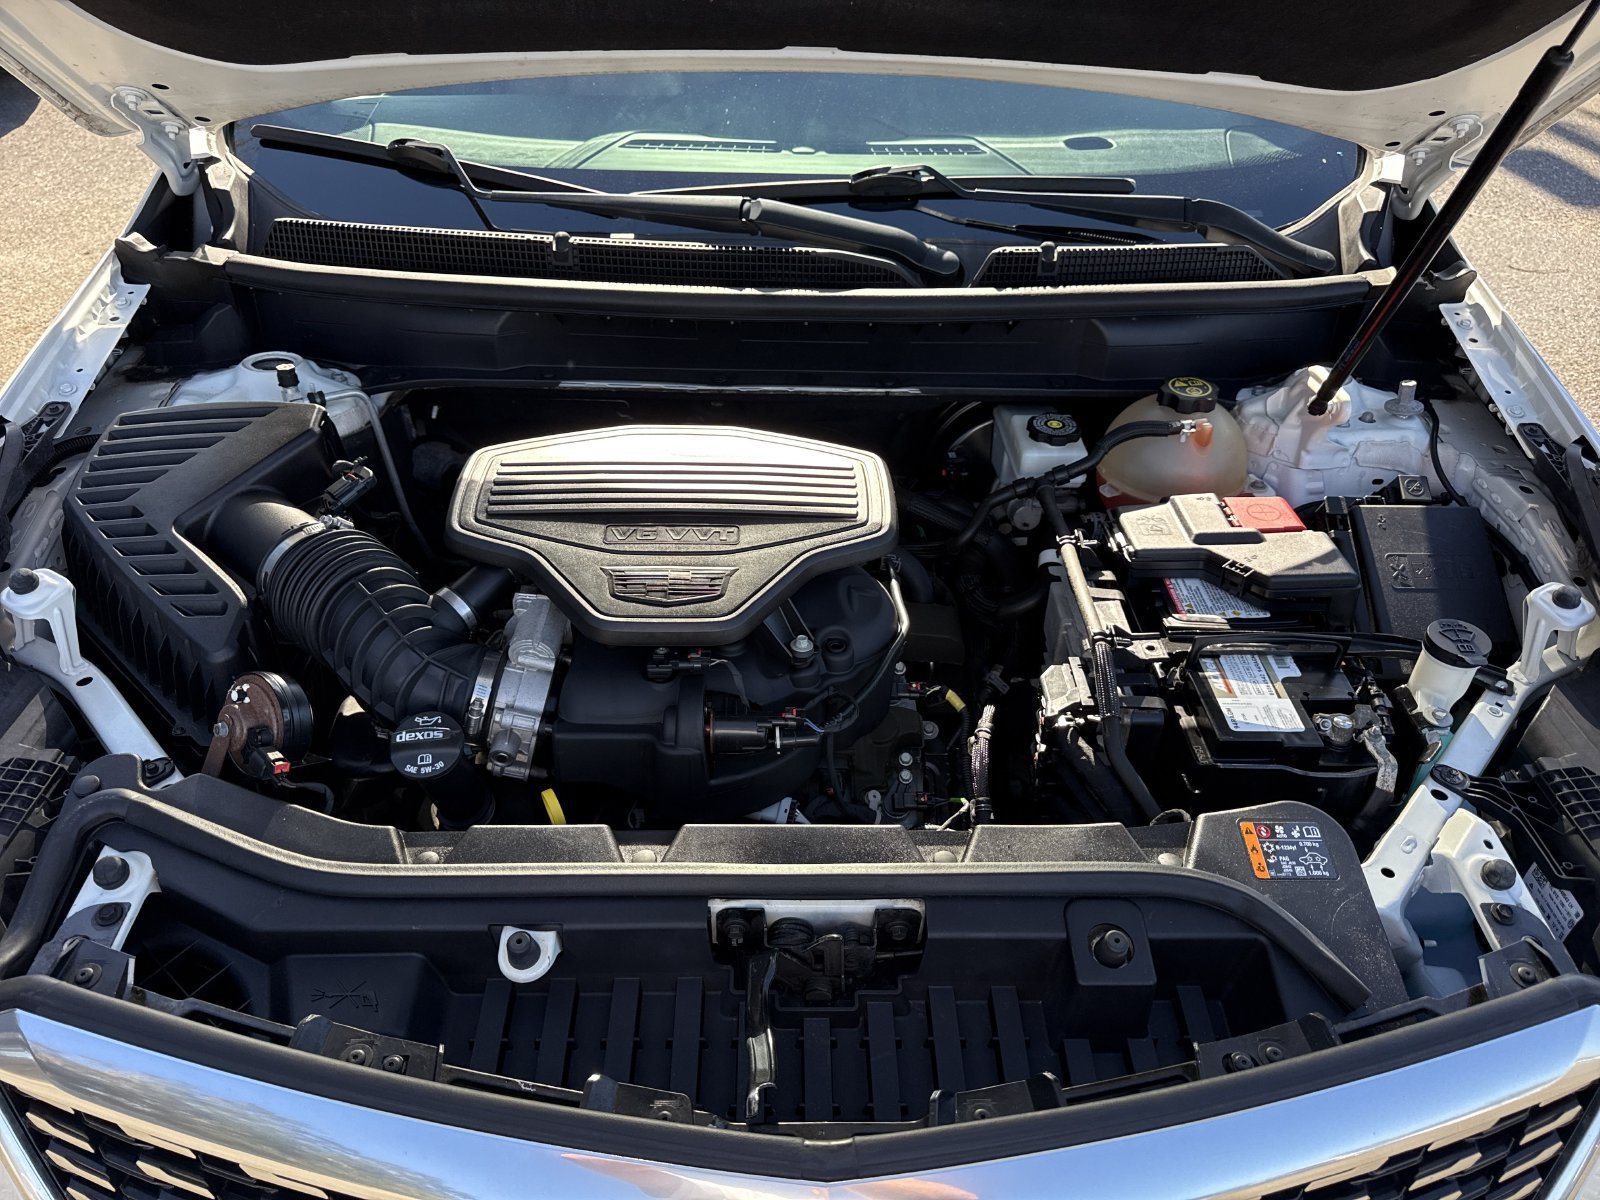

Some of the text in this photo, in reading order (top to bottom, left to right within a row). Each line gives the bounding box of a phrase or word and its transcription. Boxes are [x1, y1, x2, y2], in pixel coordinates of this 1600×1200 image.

[610, 528, 735, 541] V6 VVT
[396, 730, 443, 742] dexos
[405, 760, 445, 774] SAE 5W-30
